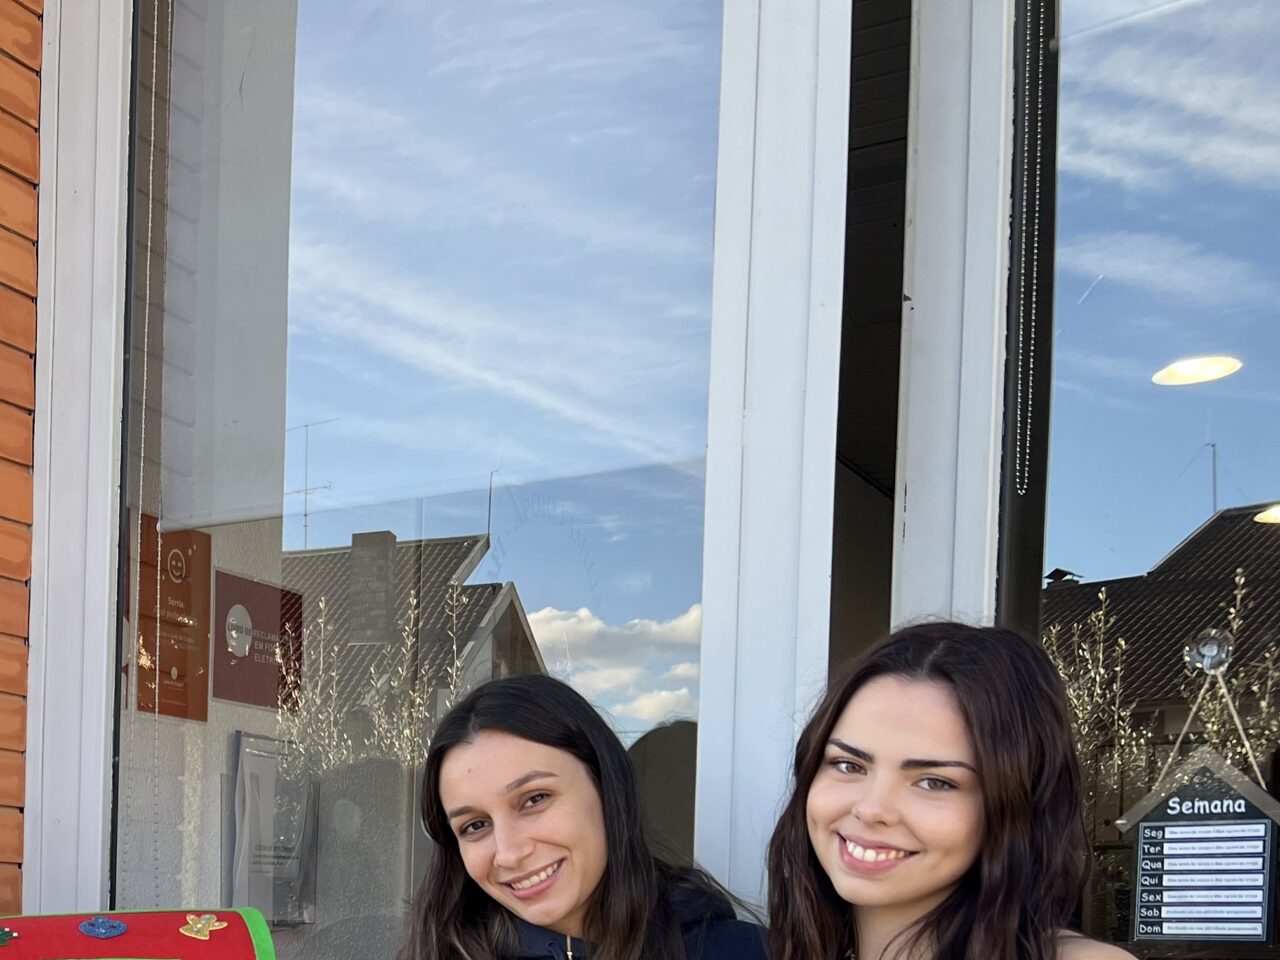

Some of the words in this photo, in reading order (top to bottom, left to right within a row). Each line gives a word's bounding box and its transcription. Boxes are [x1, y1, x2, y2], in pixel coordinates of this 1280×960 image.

[1166, 797, 1246, 815] Semana
[1143, 828, 1163, 839] Seg
[1143, 844, 1161, 854] Ter
[1141, 860, 1163, 871] Qua
[1141, 876, 1159, 886] Qui
[1141, 892, 1162, 902] Sex
[1139, 907, 1160, 917] Sab
[1139, 924, 1162, 933] Dom
